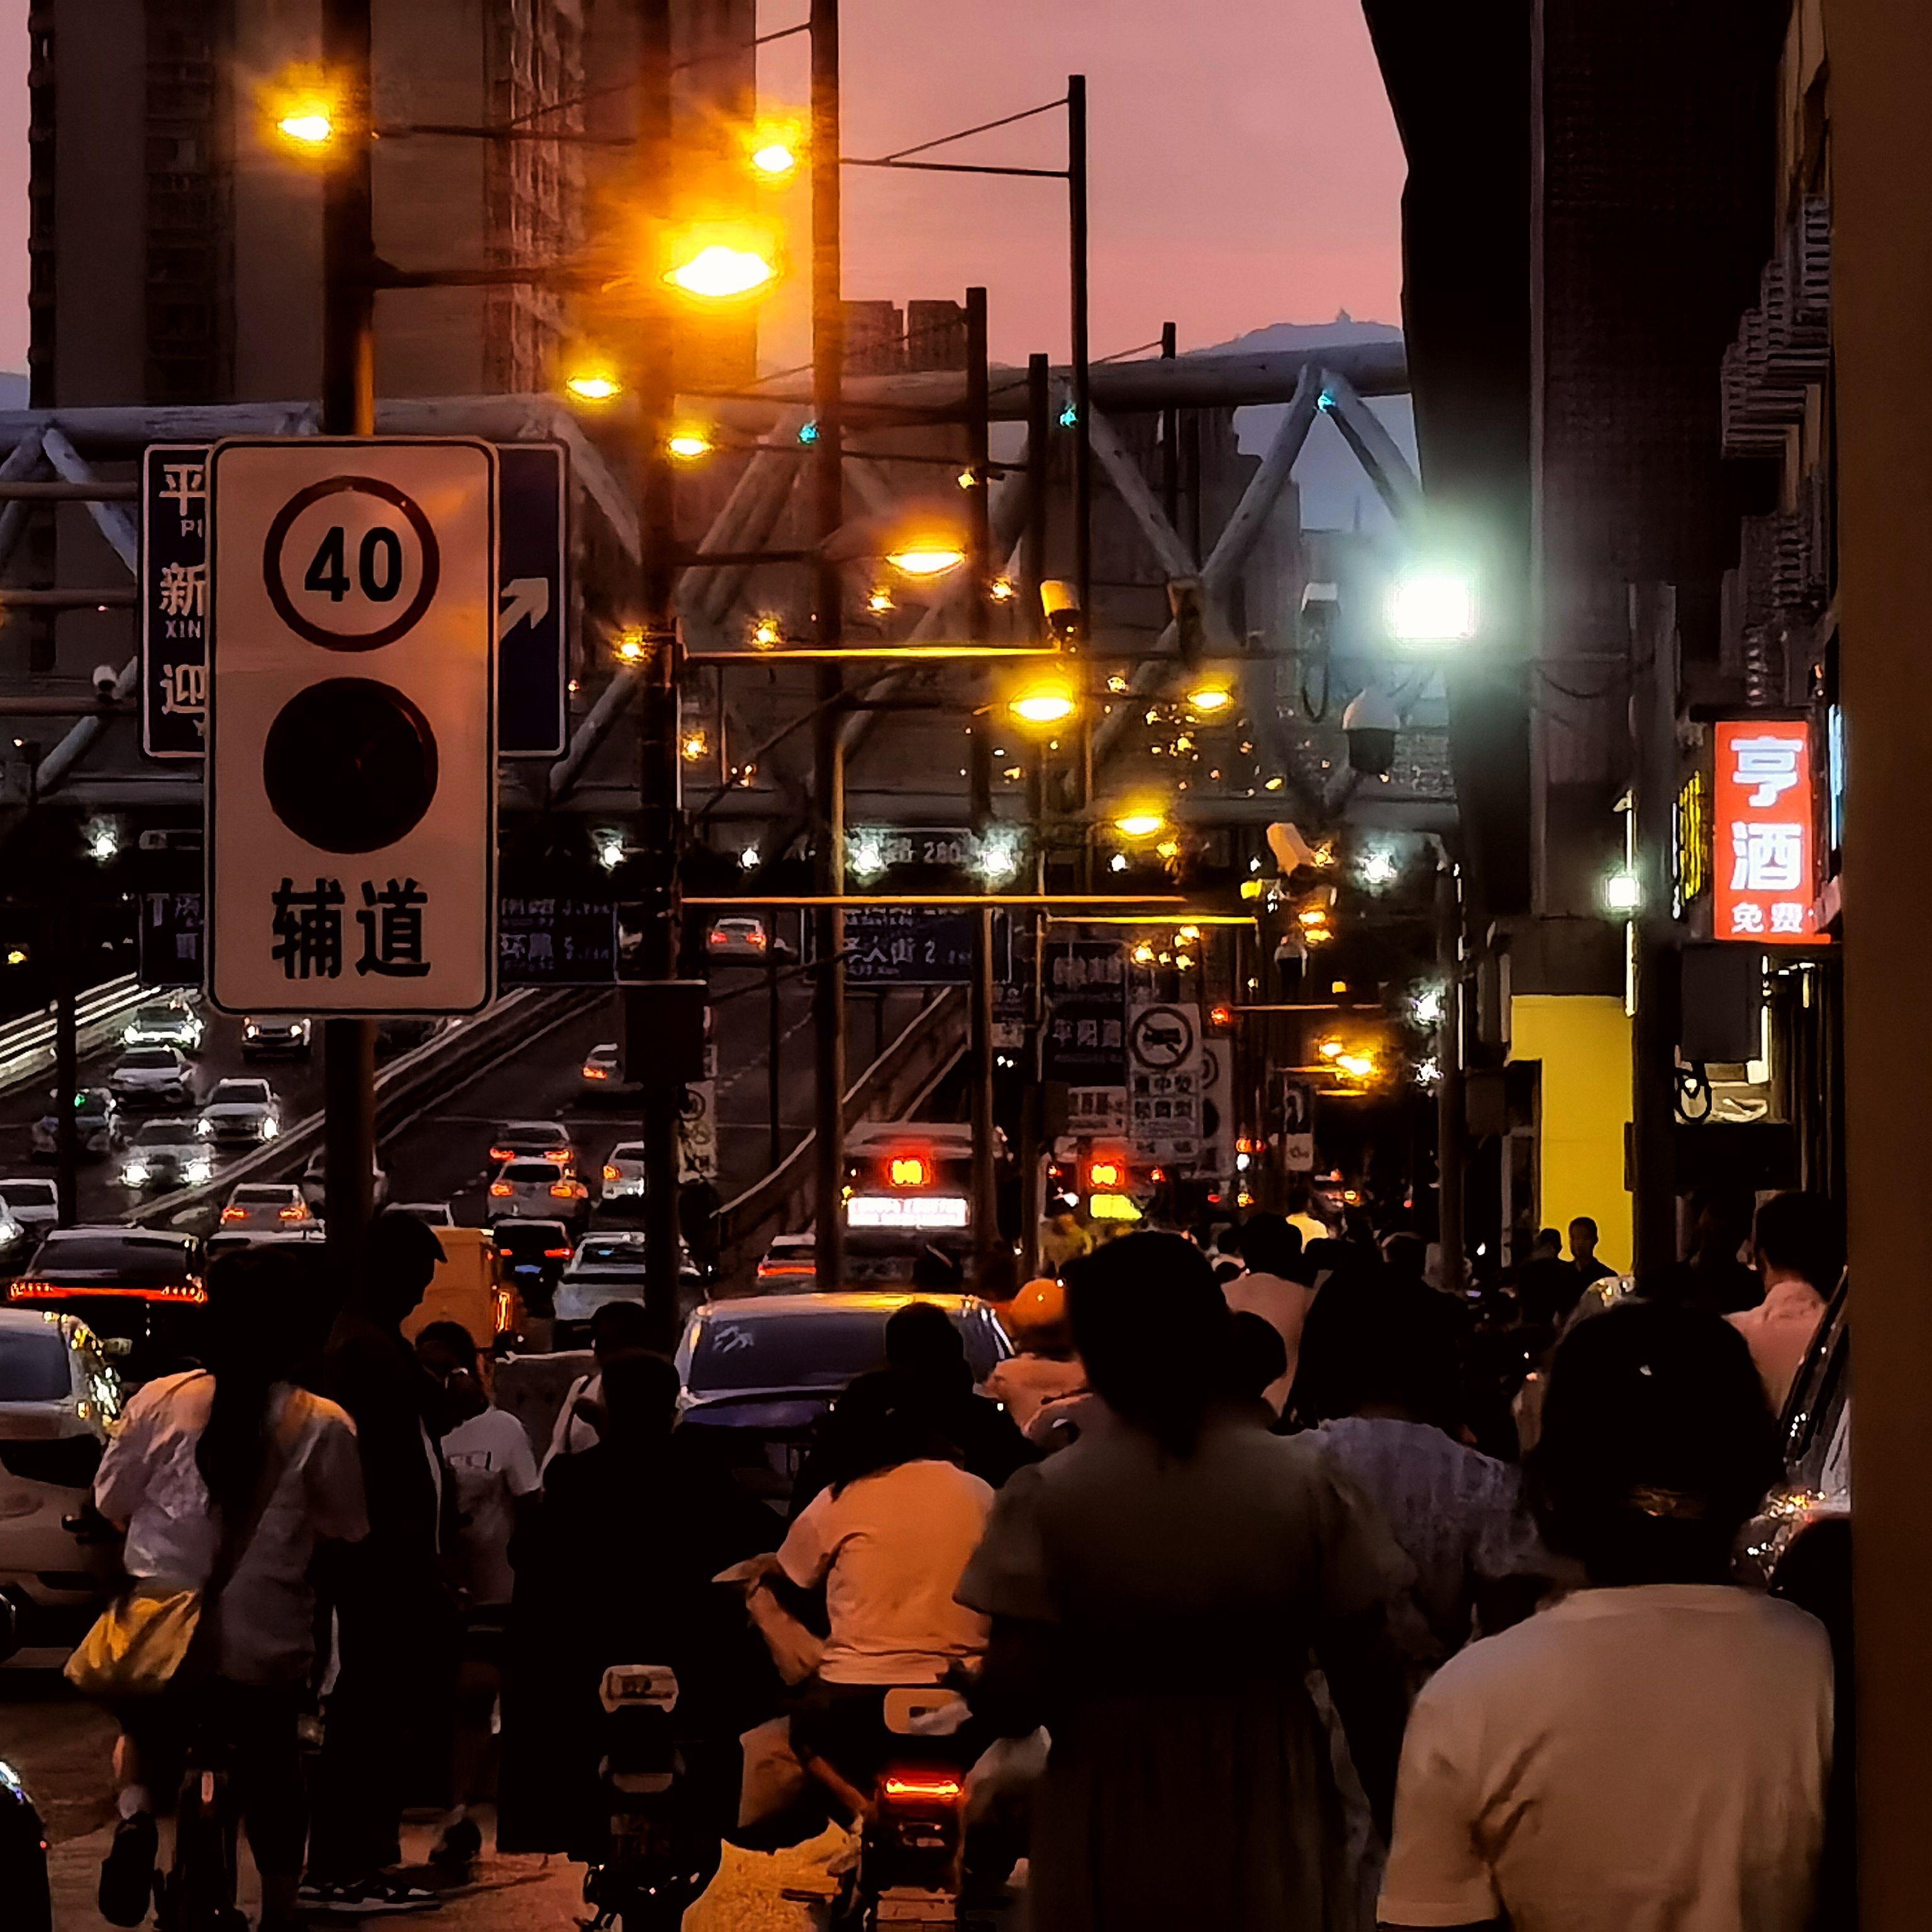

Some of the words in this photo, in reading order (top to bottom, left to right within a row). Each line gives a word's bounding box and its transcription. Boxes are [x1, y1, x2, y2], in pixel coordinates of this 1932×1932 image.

[304, 526, 402, 602] 40
[271, 877, 431, 979] 辅道
[1730, 901, 1804, 933] 免费
